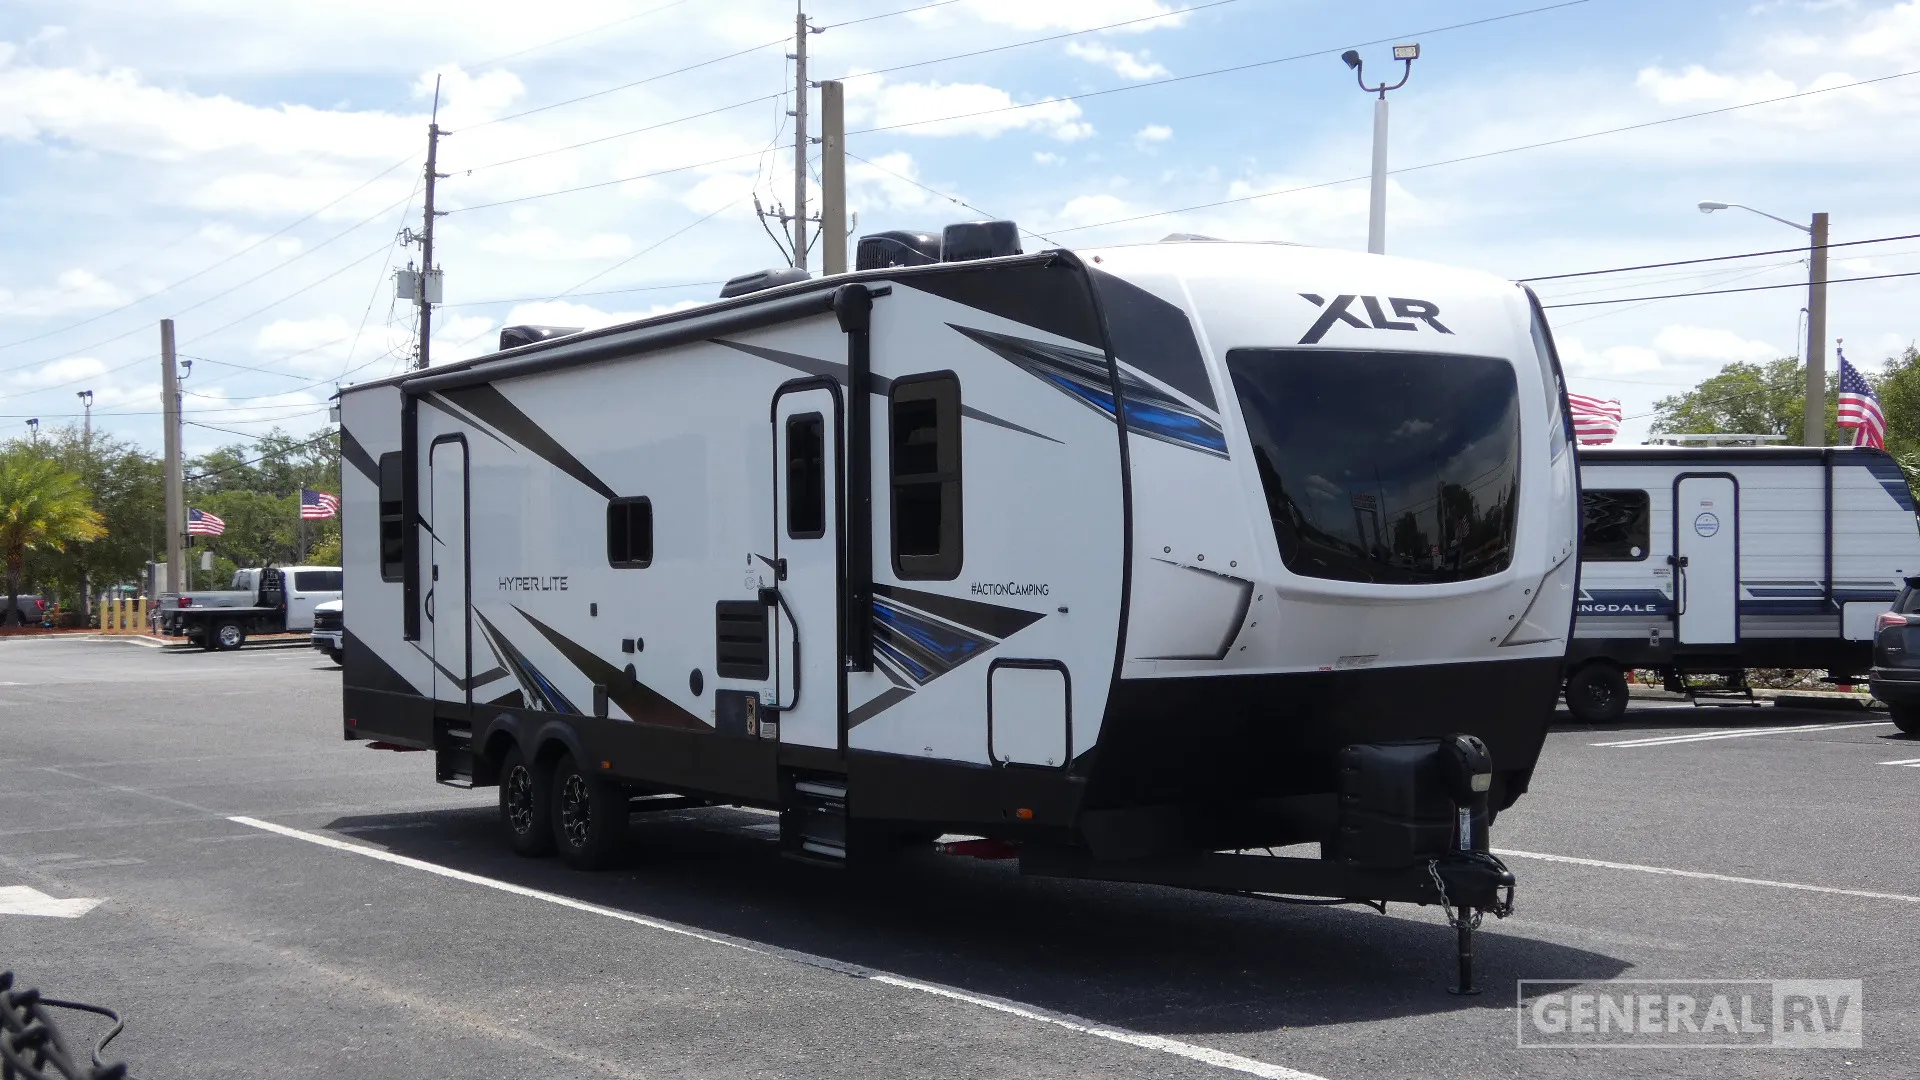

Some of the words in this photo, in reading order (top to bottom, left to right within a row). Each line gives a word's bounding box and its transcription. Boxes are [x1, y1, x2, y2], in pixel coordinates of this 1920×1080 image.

[1296, 293, 1456, 344] XLR
[499, 576, 540, 591] HYPER
[541, 576, 569, 591] LITE
